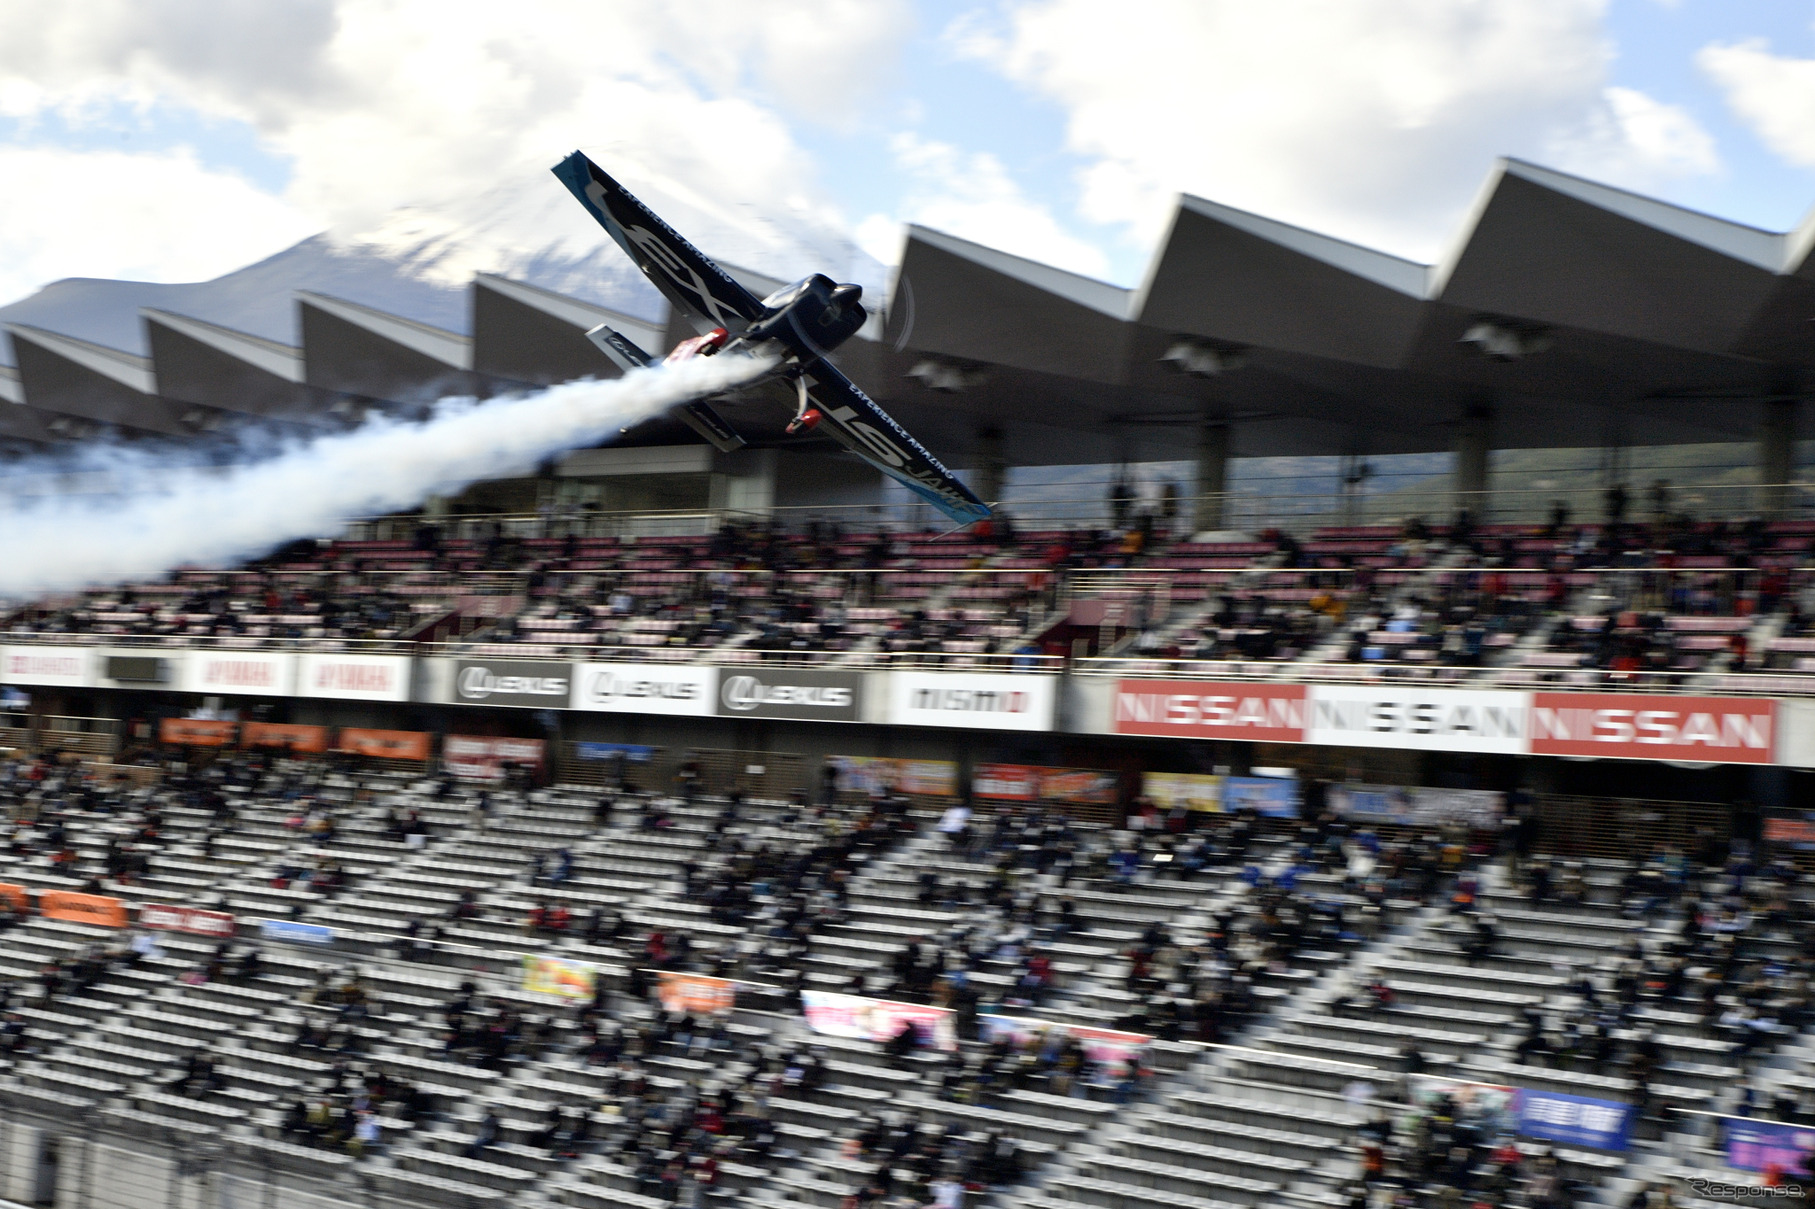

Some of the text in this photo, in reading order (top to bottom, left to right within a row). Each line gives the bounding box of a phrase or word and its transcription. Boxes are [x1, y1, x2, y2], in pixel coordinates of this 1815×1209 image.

[849, 382, 955, 480] EXPERIENCE AMAZING
[757, 684, 854, 708] LEXUS
[1115, 692, 1306, 729] NISSAN
[1312, 698, 1526, 739] NISSAN
[1531, 706, 1772, 750] NISSAN
